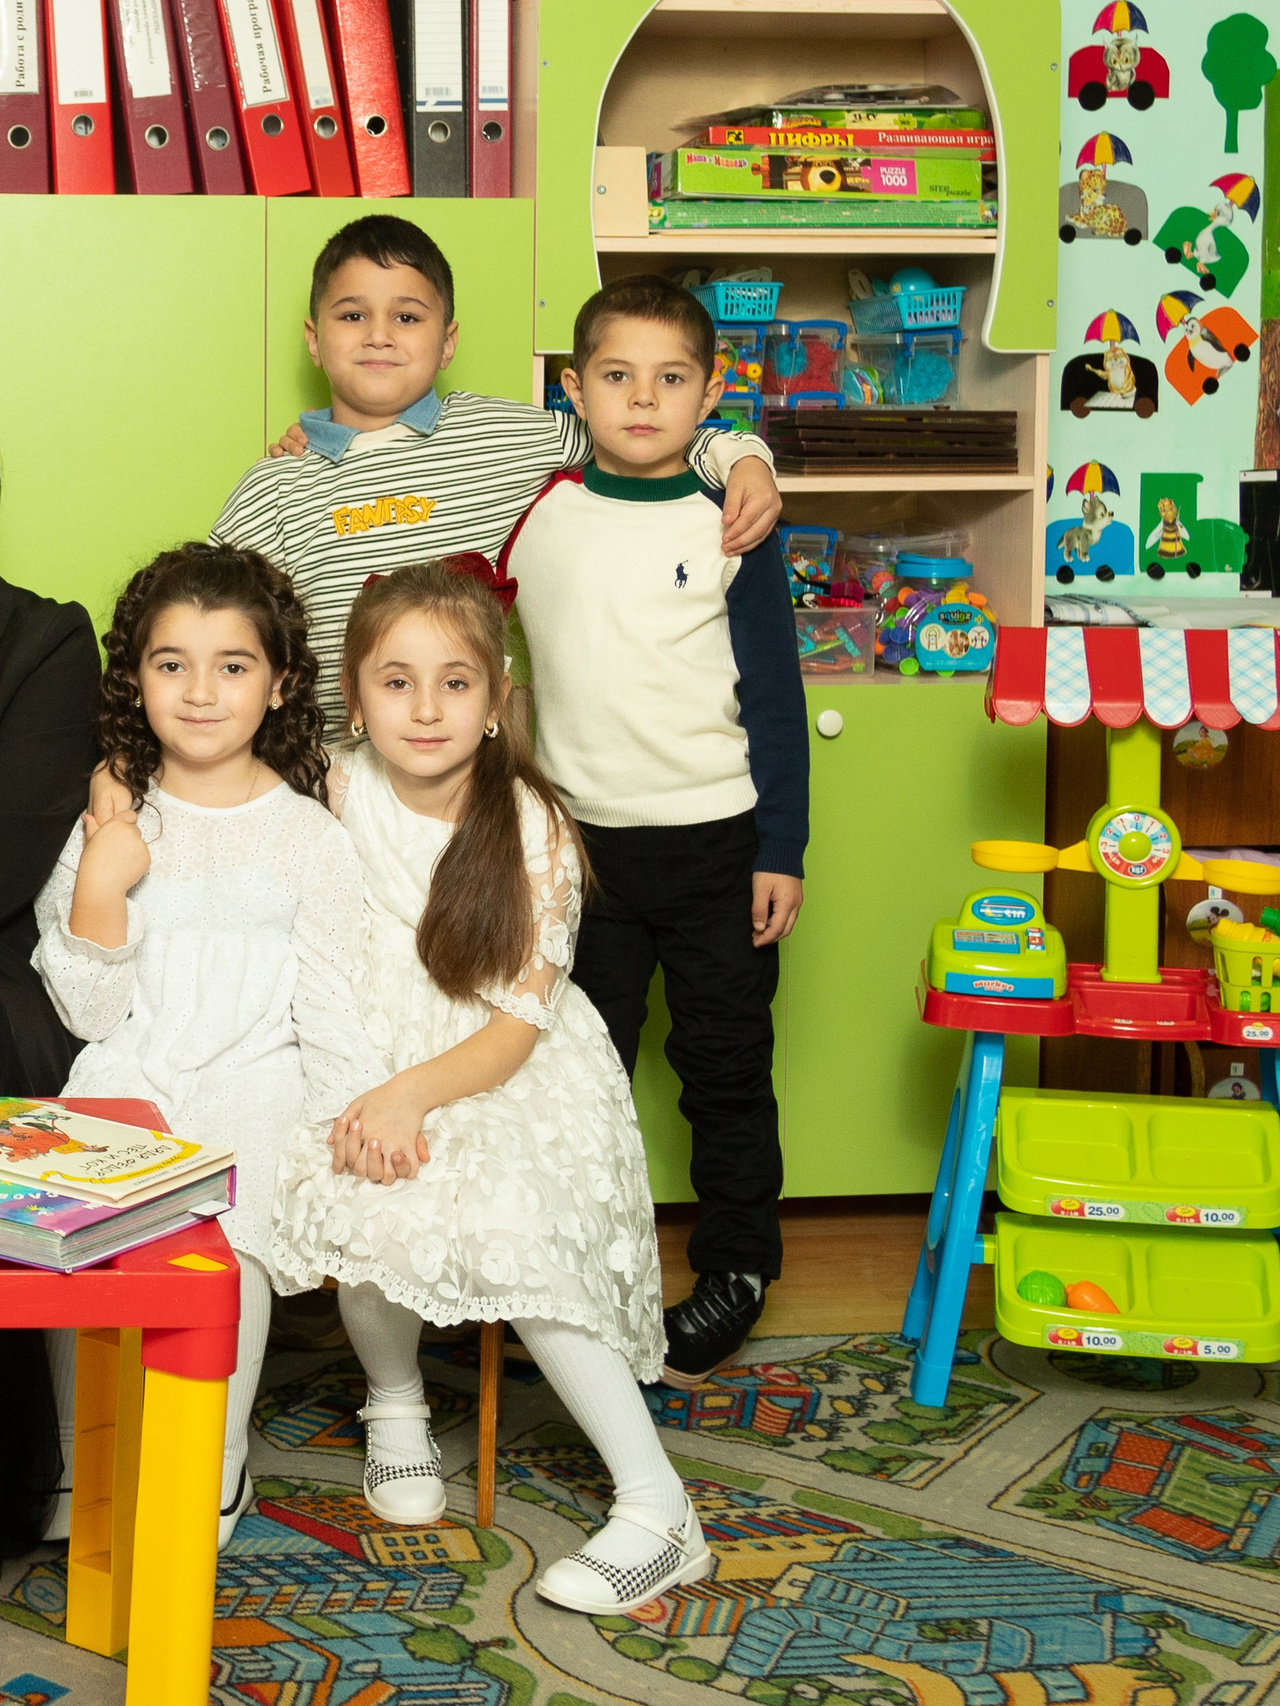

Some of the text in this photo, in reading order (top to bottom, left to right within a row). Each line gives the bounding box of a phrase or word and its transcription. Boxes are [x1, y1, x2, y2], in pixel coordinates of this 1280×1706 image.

[14, 0, 26, 31] роди
[247, 0, 272, 93] Рабочая програ
[14, 45, 25, 88] Работа
[769, 132, 994, 147] ЦИФРЫ Развивающая игра
[687, 153, 707, 165] Маша
[880, 166, 905, 175] PUZZLE
[881, 175, 907, 186] 1000
[946, 189, 970, 197] puzzle
[332, 495, 437, 537] FANTASY
[77, 1158, 106, 1173] КОТ
[95, 1145, 172, 1178] ДЯДЯ ФЁДОР
[1088, 1206, 1120, 1217] 25.00
[1204, 1212, 1235, 1222] 10.00
[1085, 1335, 1117, 1346] 10.00
[1203, 1345, 1231, 1355] 5.00
